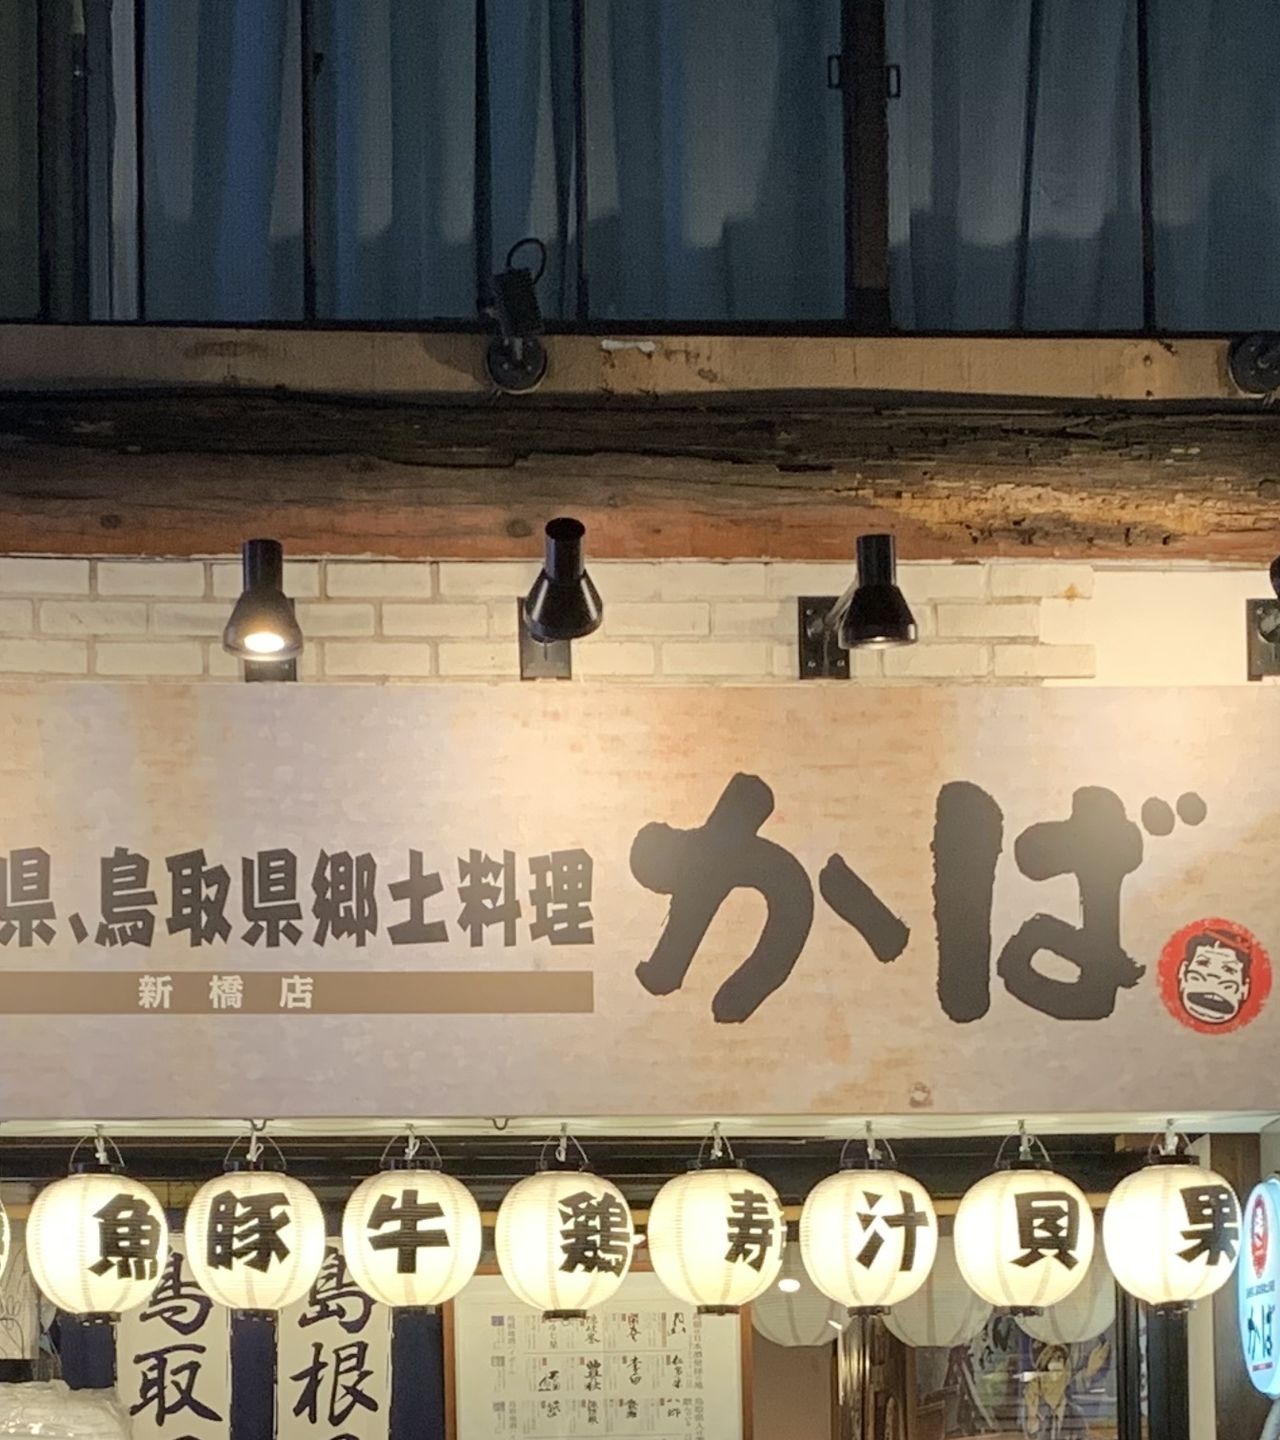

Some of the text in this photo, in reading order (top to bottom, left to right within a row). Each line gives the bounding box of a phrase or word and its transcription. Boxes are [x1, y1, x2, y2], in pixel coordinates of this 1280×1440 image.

[629, 772, 1208, 1025] かば
[137, 973, 316, 1011] 新橋店
[88, 1193, 161, 1282] 魚
[207, 1190, 292, 1275] 豚
[366, 1190, 450, 1274] 牛
[557, 1190, 630, 1277] 鶏
[724, 1189, 787, 1273] 寿
[856, 1191, 930, 1273] 汁
[1013, 1192, 1081, 1271] 貝
